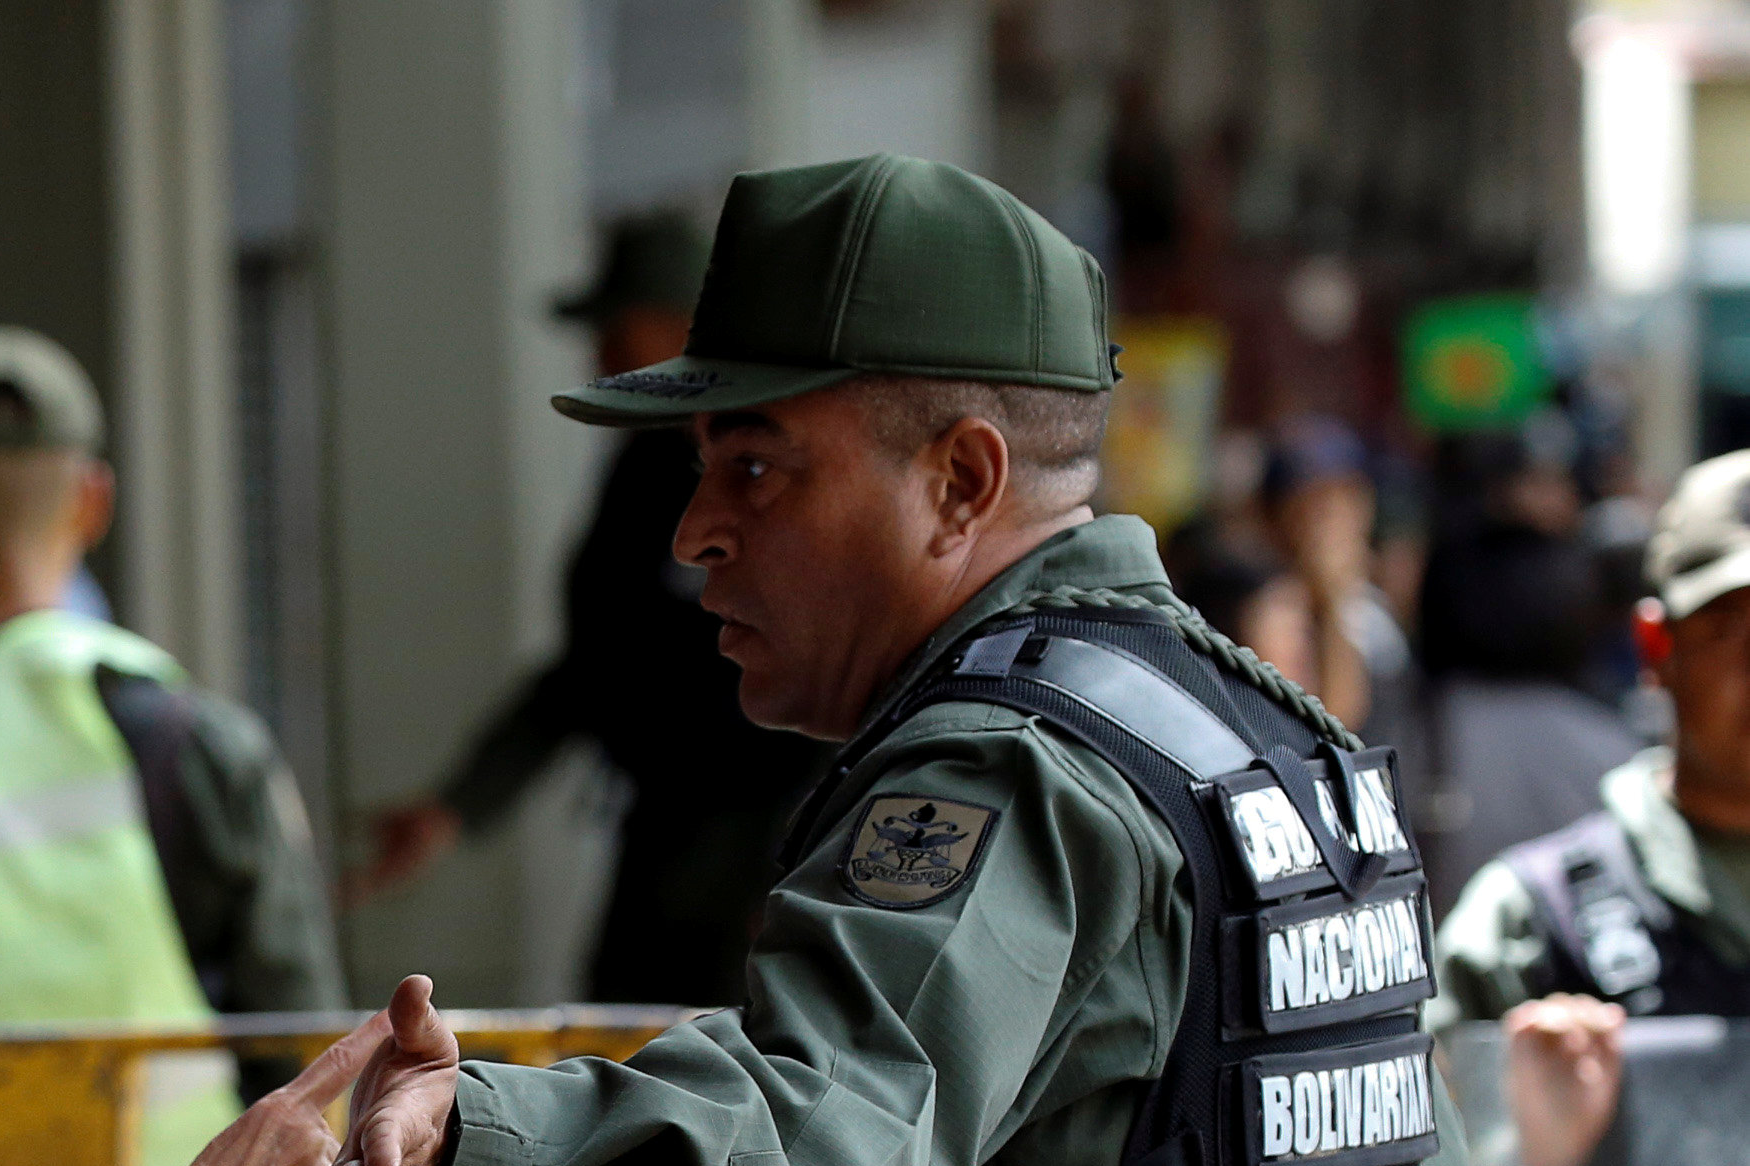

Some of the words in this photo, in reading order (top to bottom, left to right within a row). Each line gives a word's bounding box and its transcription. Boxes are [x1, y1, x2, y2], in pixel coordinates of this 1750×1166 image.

[1231, 768, 1408, 879] GURDIA
[1268, 898, 1428, 1011] NACIONAL
[1261, 1053, 1435, 1157] BOLIVARIAN
